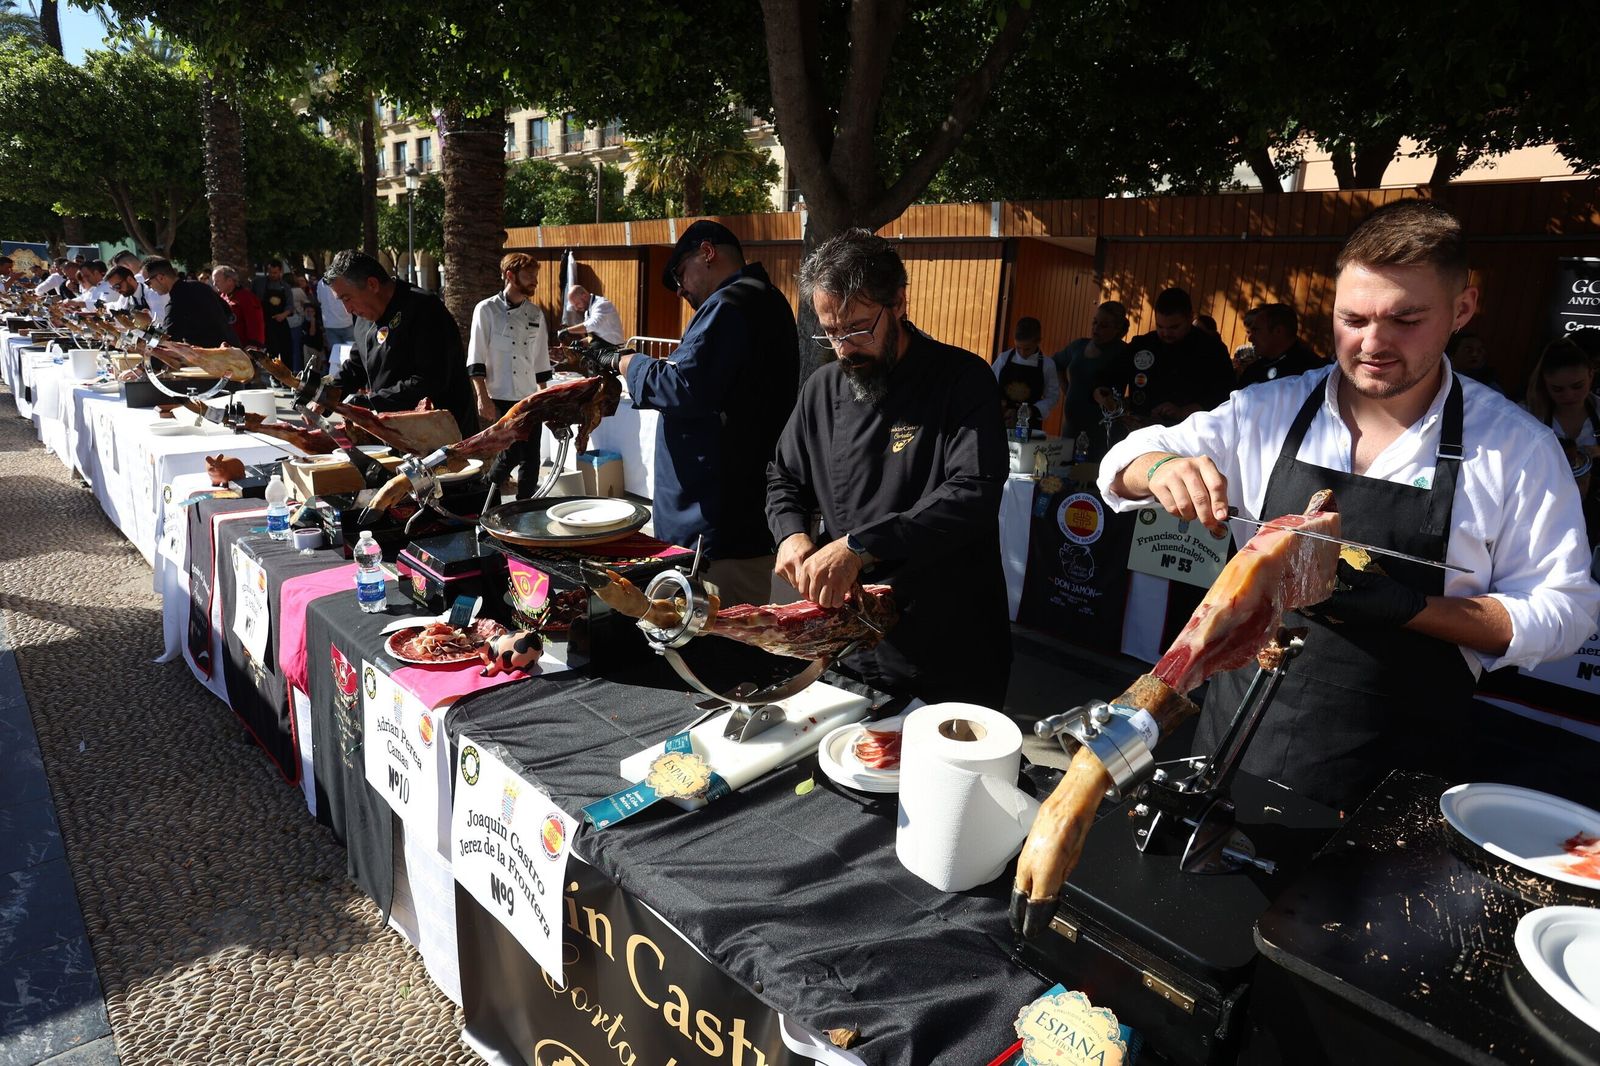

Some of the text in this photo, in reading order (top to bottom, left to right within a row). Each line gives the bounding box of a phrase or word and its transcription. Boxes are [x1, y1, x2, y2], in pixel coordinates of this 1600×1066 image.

[1137, 531, 1221, 563] Francisco J Pecero
[1151, 543, 1205, 564] Almendralejo
[1177, 558, 1193, 573] 53
[376, 716, 423, 771] Adrian Perea
[387, 740, 409, 770] Camas
[467, 809, 508, 842] Joaquin
[510, 831, 545, 896] Castro
[460, 836, 551, 940] Jerez de la Frontera
[1035, 1010, 1105, 1066] ESPAÑA
